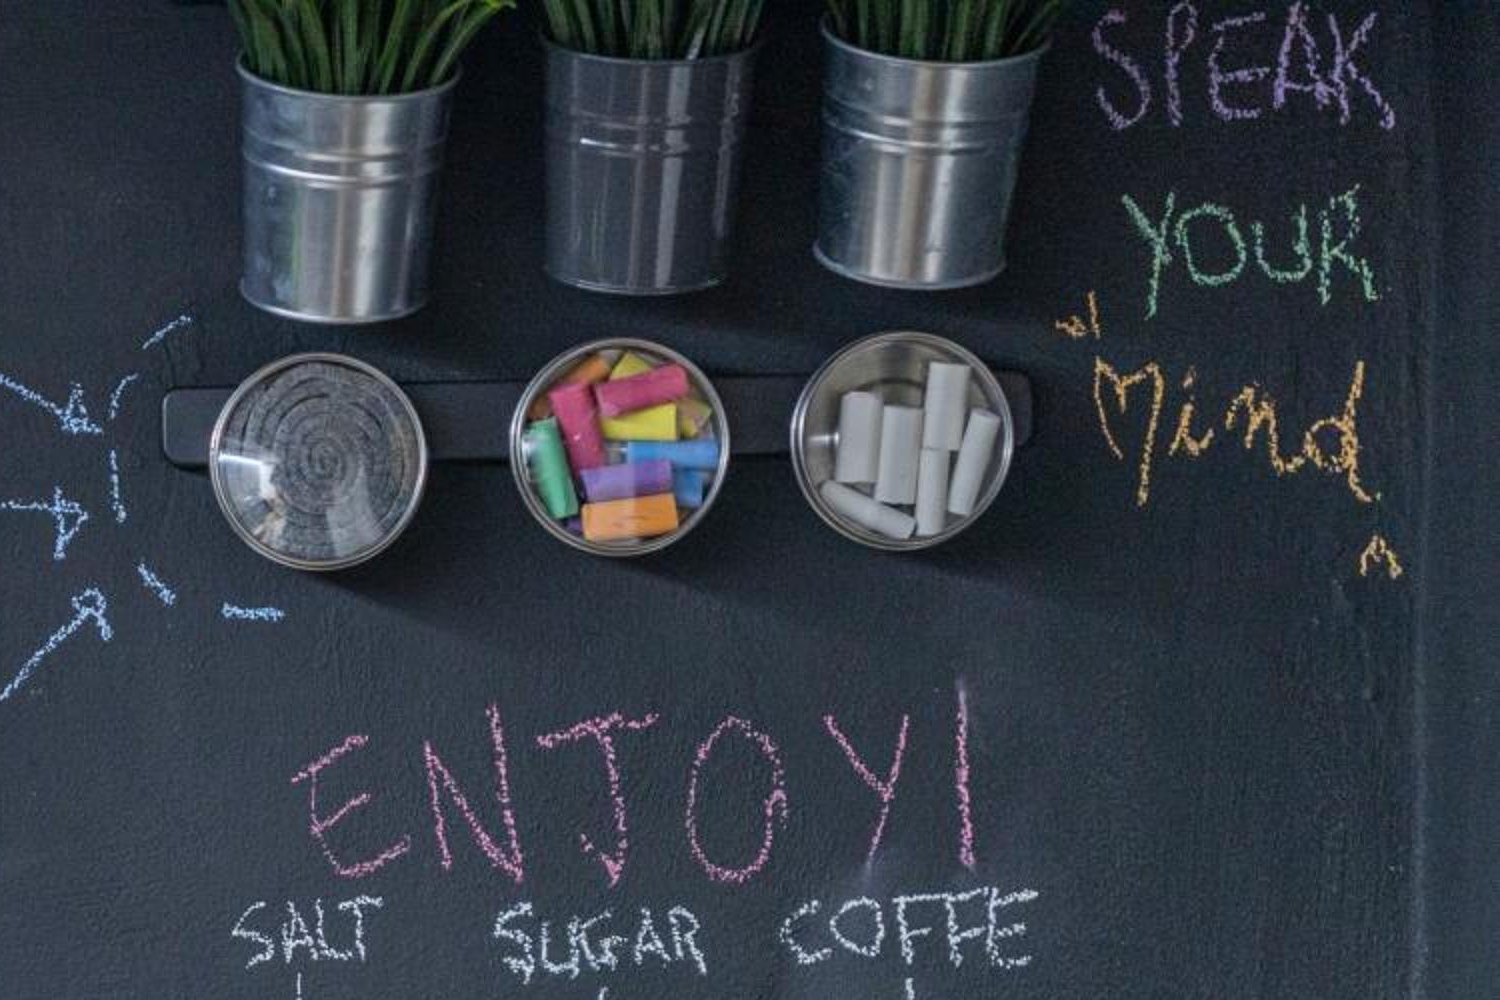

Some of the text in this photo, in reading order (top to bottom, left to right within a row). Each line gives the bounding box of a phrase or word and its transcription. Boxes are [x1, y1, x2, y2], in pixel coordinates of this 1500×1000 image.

[1092, 0, 1395, 129] SPEAK
[1122, 184, 1382, 320] YOUR
[1094, 360, 1381, 506] Mind
[232, 895, 383, 968] SALT
[494, 902, 707, 984] SUGAR
[780, 886, 1038, 969] COFFE
